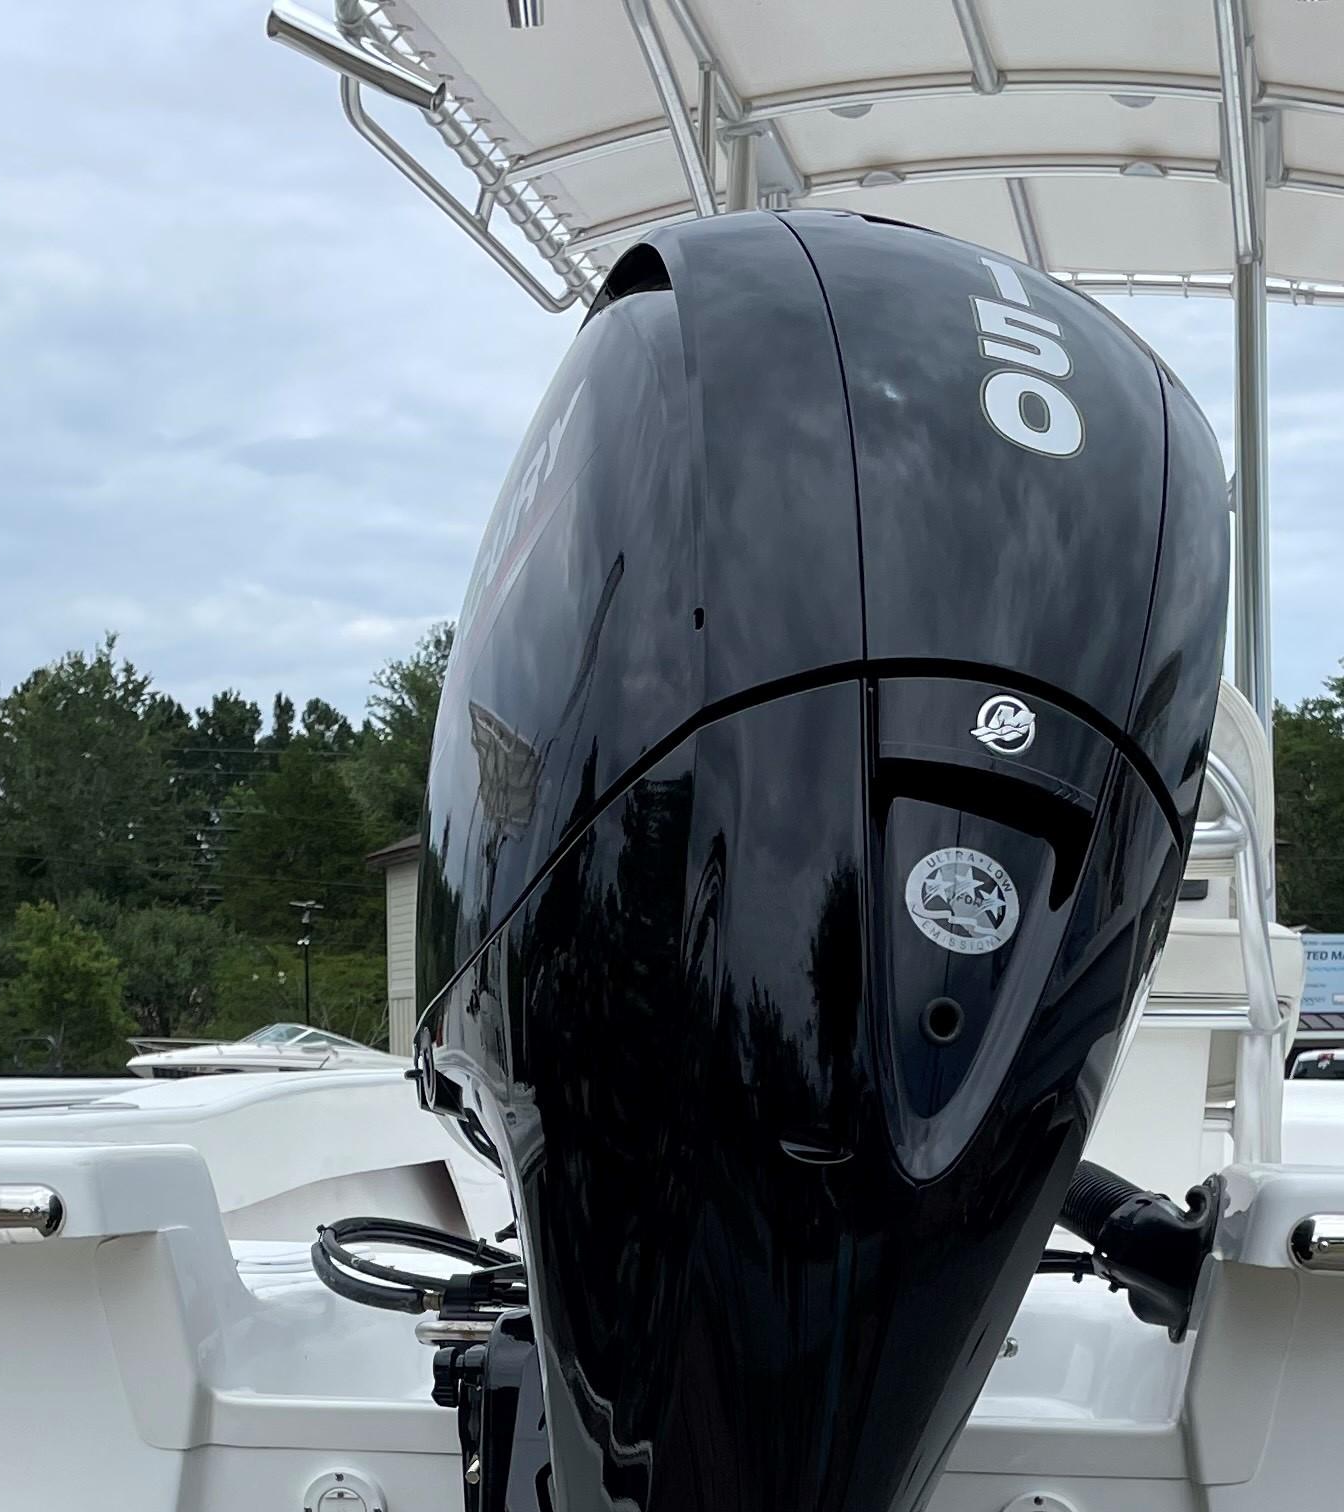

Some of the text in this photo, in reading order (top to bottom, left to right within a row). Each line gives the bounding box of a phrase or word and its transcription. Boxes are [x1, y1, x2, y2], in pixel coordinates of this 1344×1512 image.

[969, 256, 1086, 459] 150
[926, 850, 1013, 893] ULTRA LOW
[922, 921, 995, 951] EMISSION
